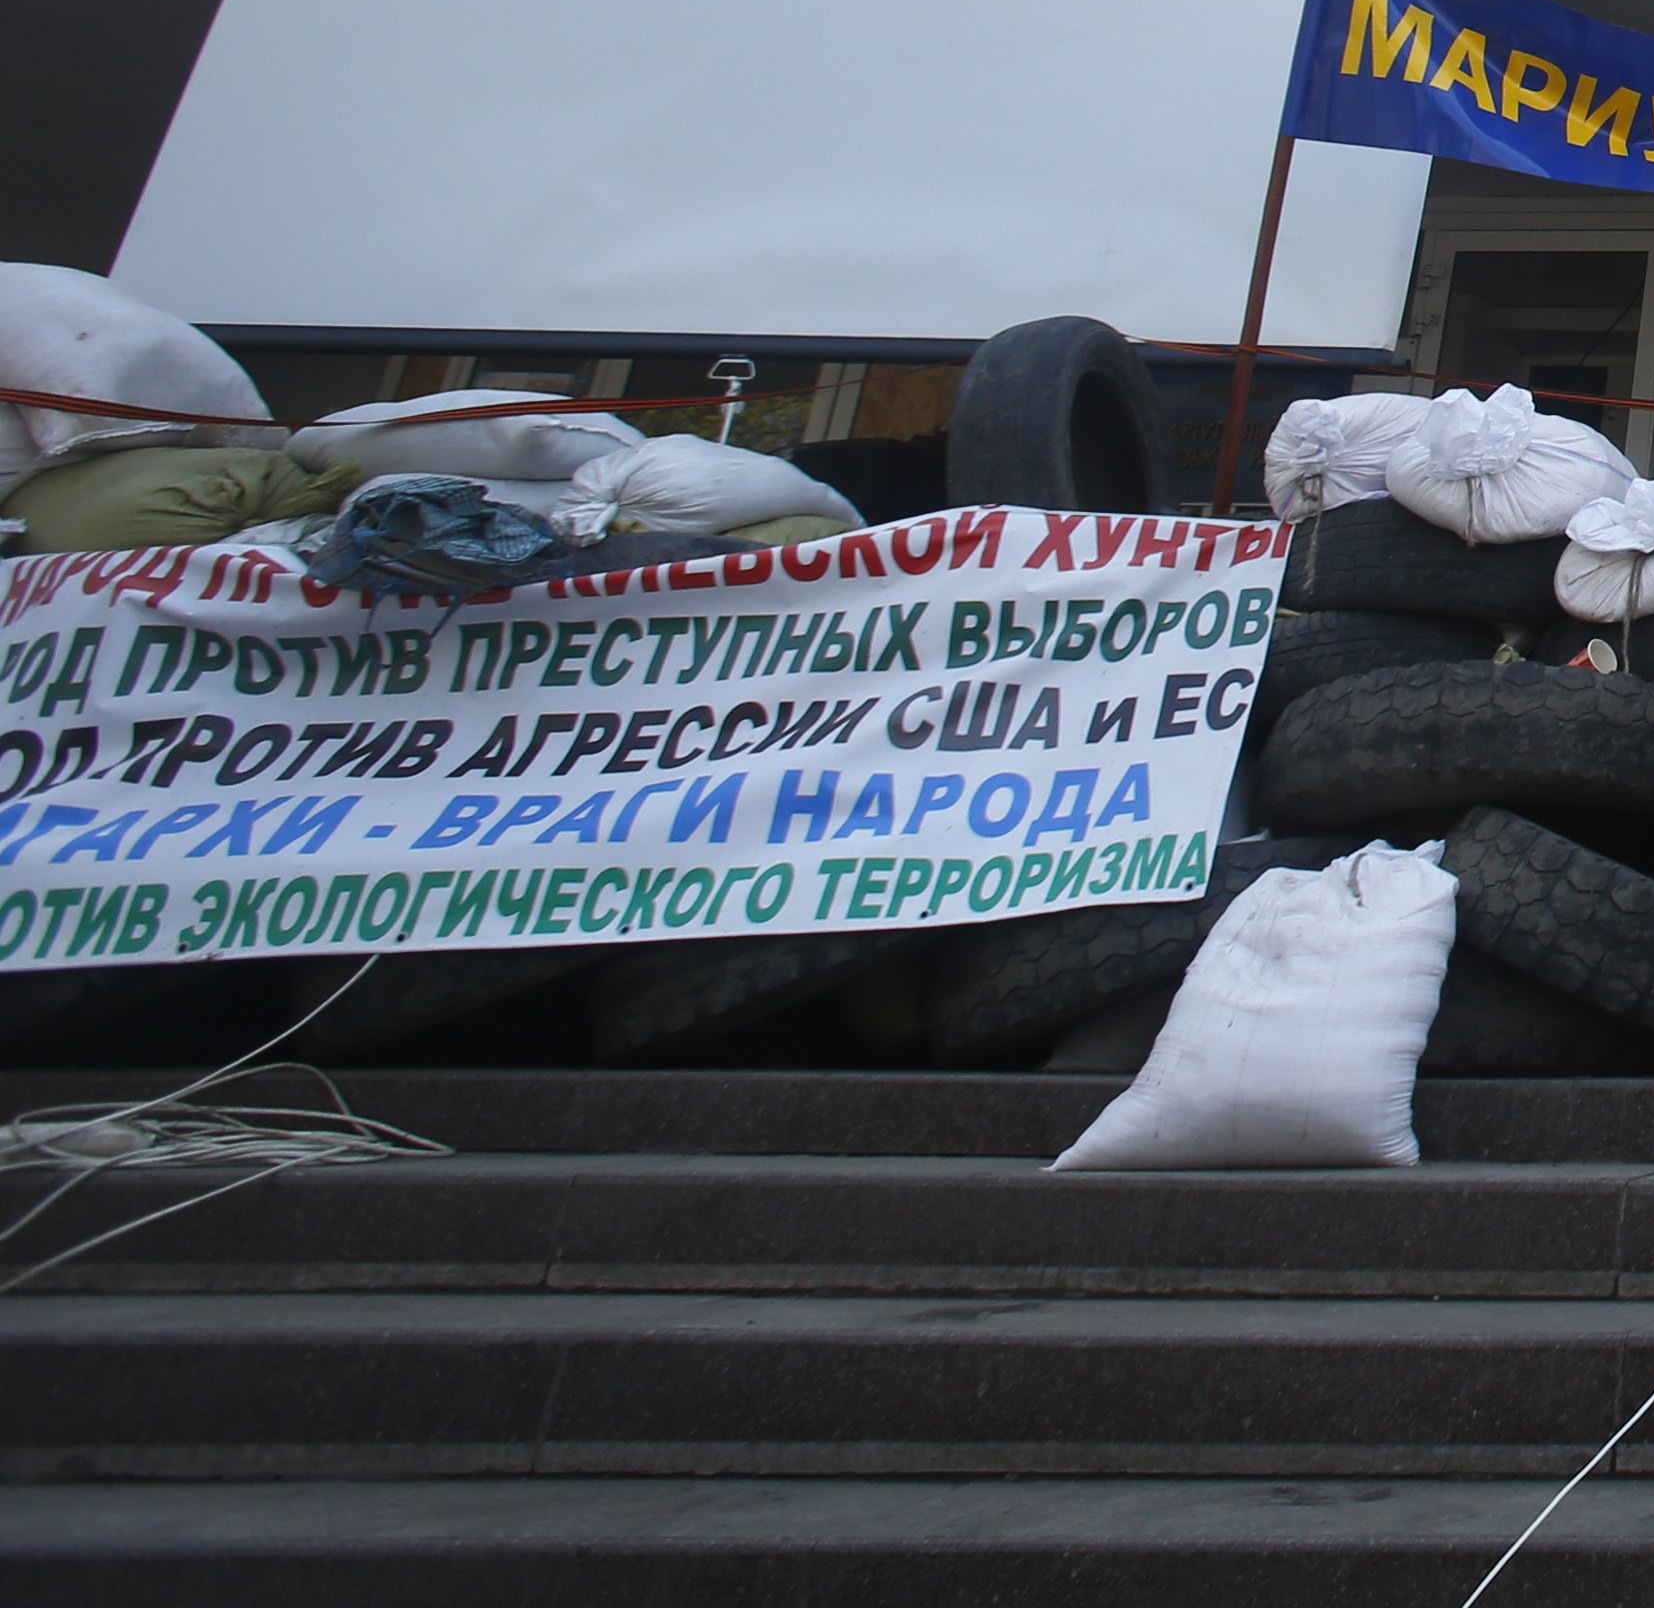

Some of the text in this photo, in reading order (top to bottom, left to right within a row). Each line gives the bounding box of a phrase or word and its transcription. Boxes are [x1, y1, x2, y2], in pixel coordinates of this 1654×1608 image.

[1022, 513, 1292, 574] ХУНТЫ
[112, 624, 431, 698] ПРОТИВ
[449, 601, 930, 695] ПРЕСТУПНЫХ
[944, 586, 1273, 670] ВЫБОРОВ
[87, 713, 455, 789] ПРОТИВ
[447, 696, 882, 779] АГРЕССИИ
[887, 680, 1060, 753] США
[1152, 667, 1256, 741] ЕС
[409, 770, 749, 851] ВРАГИ
[766, 762, 1151, 848] НАРОДА
[177, 862, 796, 954] ЭКОЛОГИЧЕСКОГО
[813, 831, 1209, 921] ТЕРРОРИЗМА
